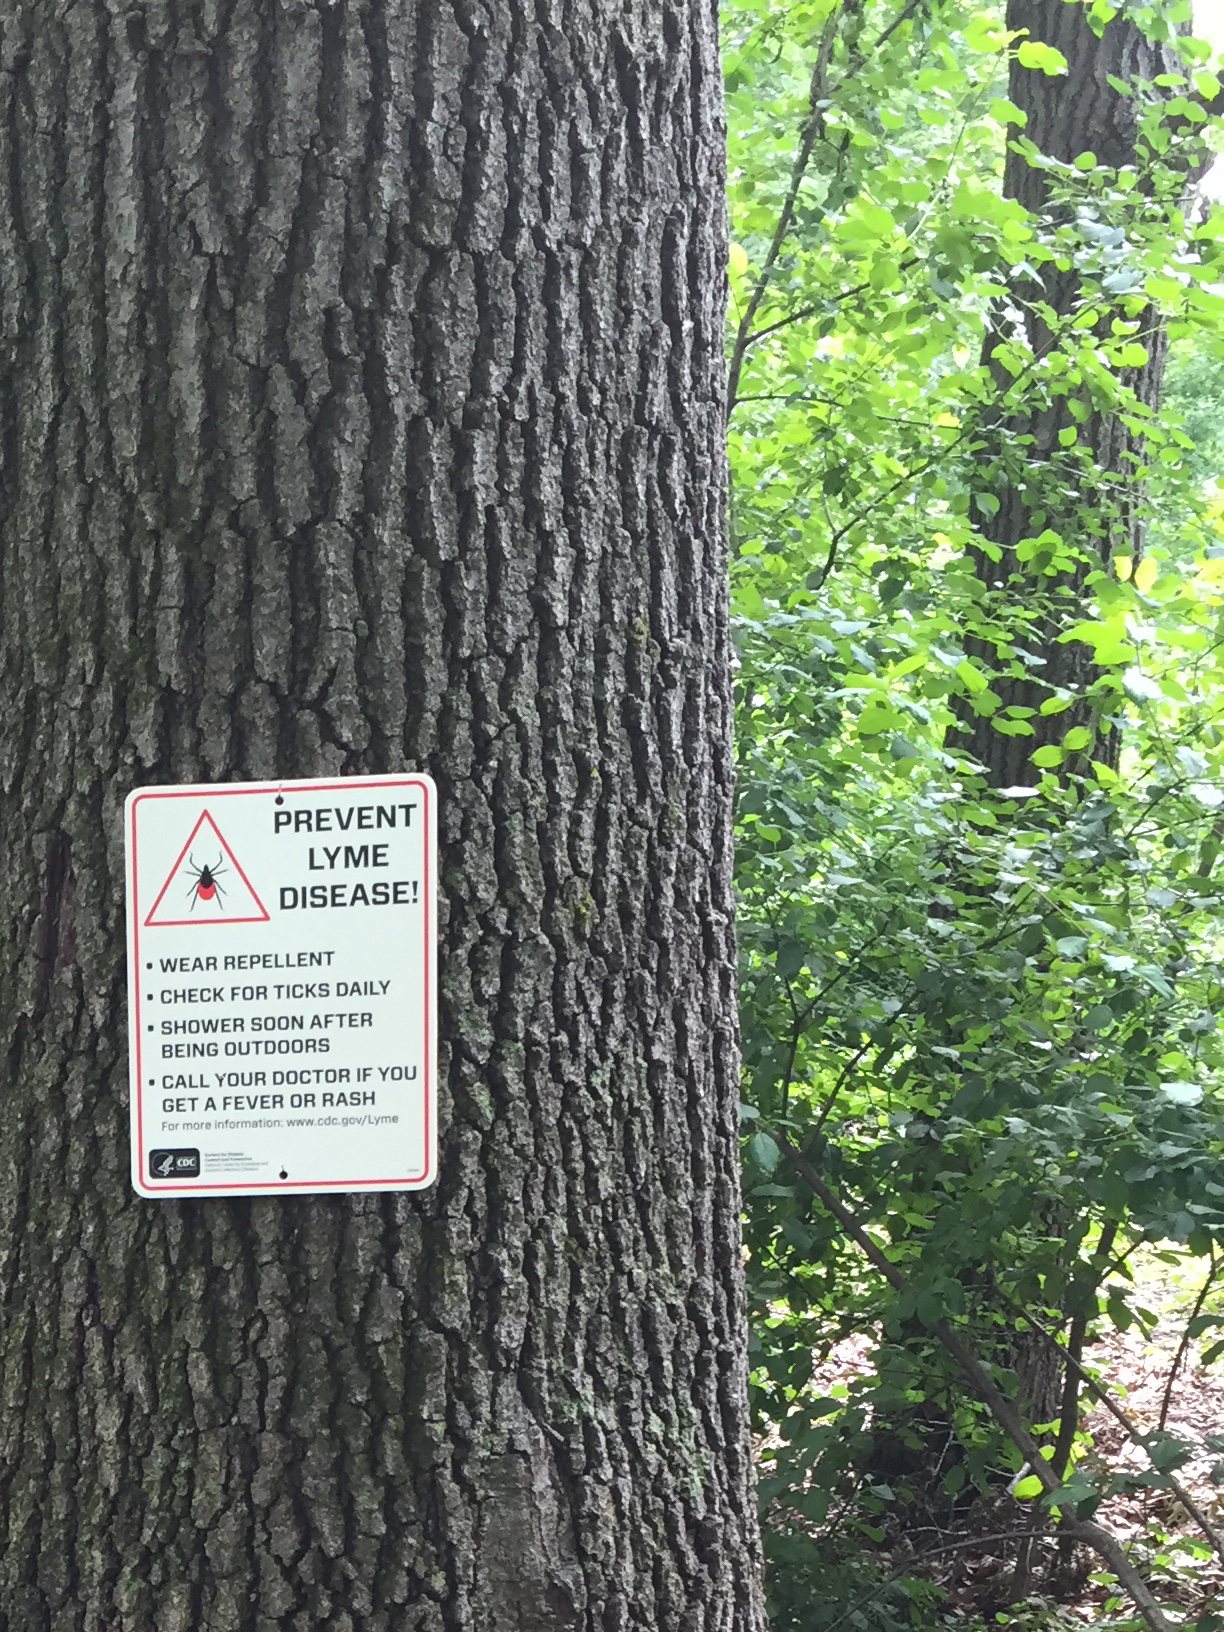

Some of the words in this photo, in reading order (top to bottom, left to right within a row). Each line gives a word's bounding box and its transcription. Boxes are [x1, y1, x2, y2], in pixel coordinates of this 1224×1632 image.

[274, 804, 417, 834] PREVENT
[308, 844, 390, 870] LYME
[279, 881, 419, 910] DISEASE!
[160, 956, 218, 973] WEAR
[223, 951, 335, 970] REPELLENT
[160, 987, 225, 1004] CHECK
[230, 985, 268, 1001] FOR
[272, 983, 331, 999] TICKS
[336, 980, 391, 997] DAILY
[160, 1018, 245, 1035] SHOWER
[250, 1015, 304, 1032] SOON
[309, 1013, 373, 1029] AFTER
[161, 1042, 219, 1059] BEING
[224, 1038, 331, 1057] OUTDOORS
[162, 1074, 211, 1090] CALL
[214, 1072, 267, 1088] YOUR
[272, 1068, 351, 1086] DOCTOR
[356, 1067, 374, 1083] IF
[377, 1066, 417, 1082] YOU
[162, 1097, 199, 1113] GET
[204, 1096, 217, 1112] A
[222, 1094, 285, 1111] FEVER
[289, 1093, 316, 1109] OR
[322, 1091, 376, 1108] RASH
[161, 1121, 180, 1131] For
[182, 1121, 212, 1130] more
[214, 1118, 284, 1129] information:
[286, 1114, 399, 1128] www.cdc.gov/Lyme
[177, 1158, 196, 1168] CDC
